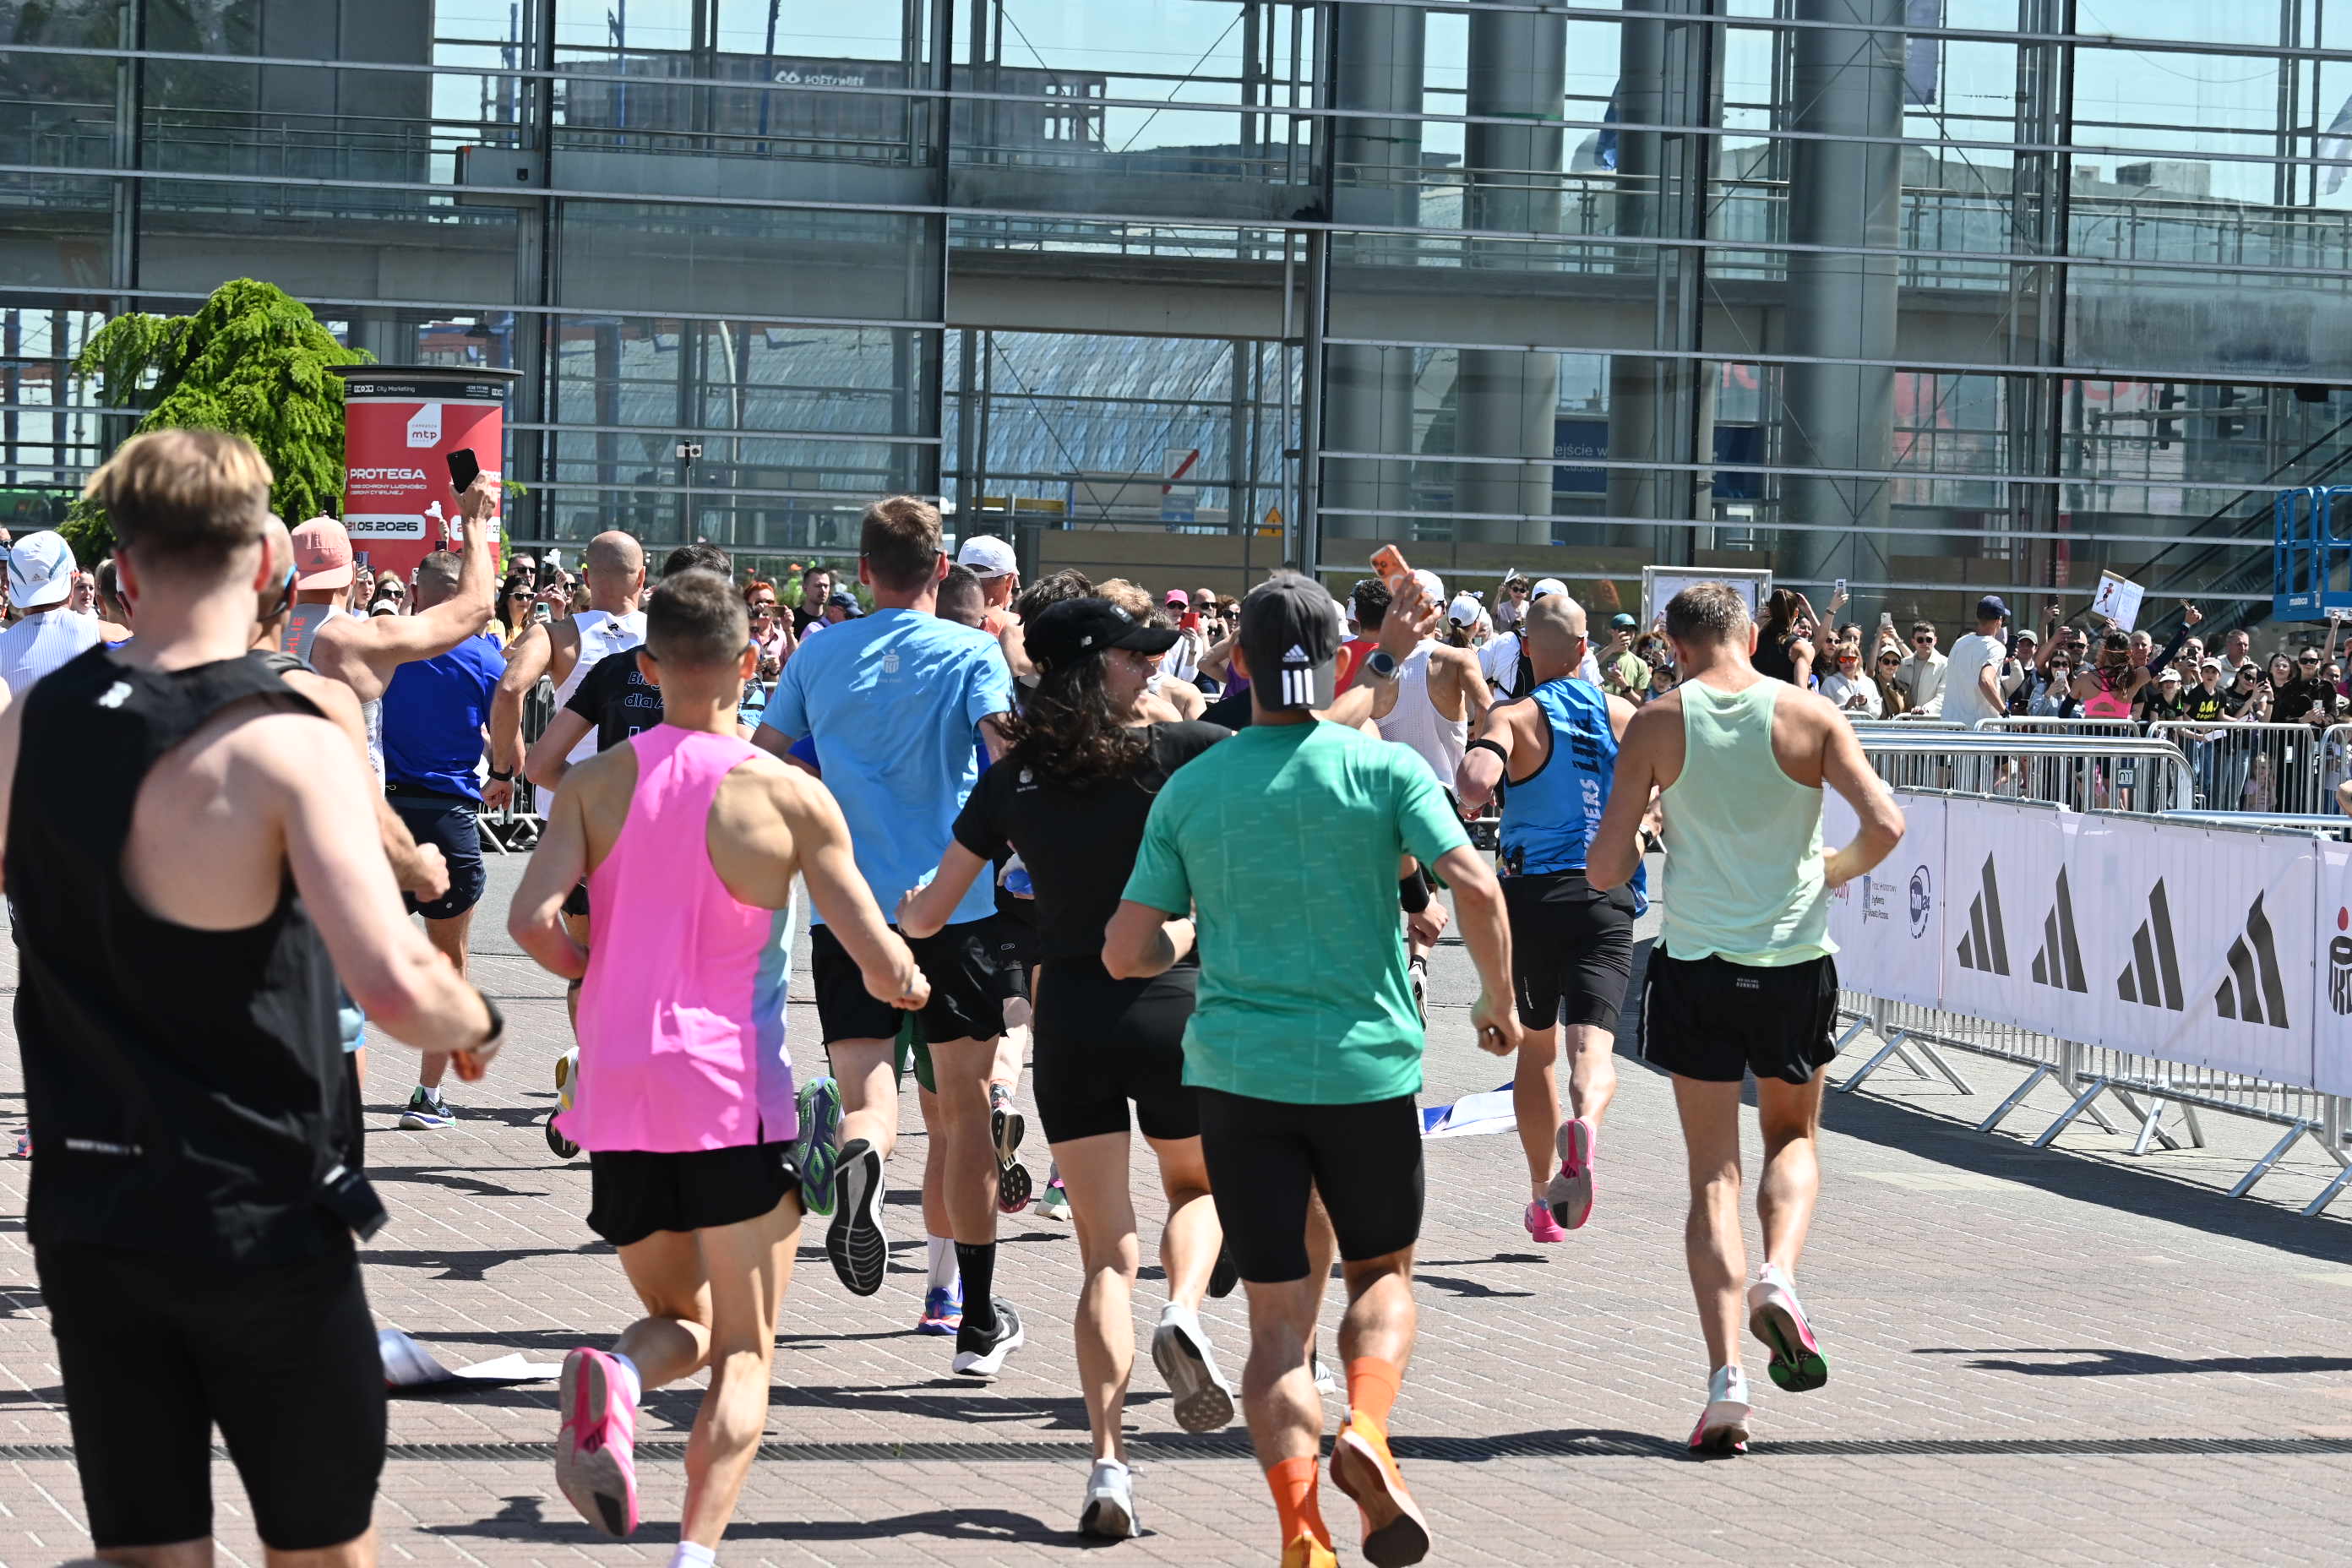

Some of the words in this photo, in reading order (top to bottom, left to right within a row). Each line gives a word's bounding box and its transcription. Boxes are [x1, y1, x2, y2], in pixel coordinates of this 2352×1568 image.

[412, 430, 438, 440] mtp
[1554, 443, 1594, 458] ejście
[350, 468, 427, 480] PROTEGA
[625, 694, 653, 708] dla
